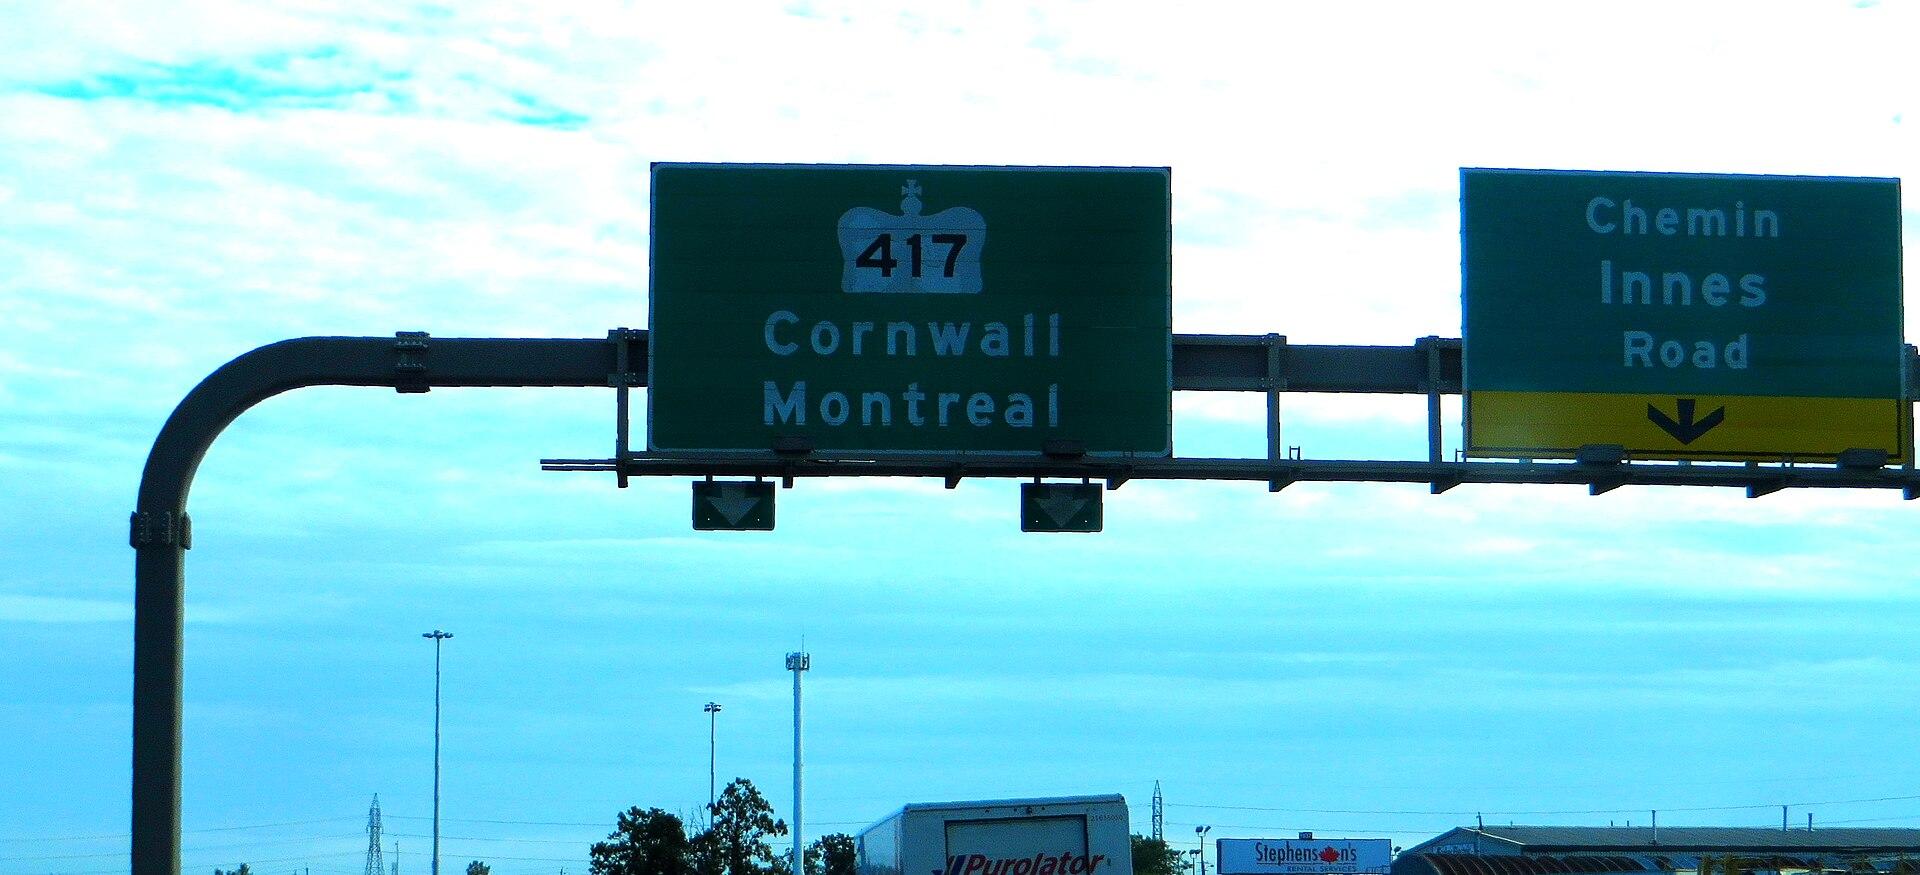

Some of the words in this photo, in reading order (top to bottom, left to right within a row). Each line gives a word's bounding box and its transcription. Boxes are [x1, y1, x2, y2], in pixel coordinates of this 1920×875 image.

[1585, 196, 1780, 238] Chemin
[855, 233, 968, 279] 417
[1600, 259, 1767, 309] Innes
[764, 310, 1060, 358] Cornwall
[1623, 330, 1749, 370] Road
[763, 380, 1060, 429] Montreal
[965, 852, 1105, 875] Purolator
[1255, 841, 1357, 865] Stephensn's
